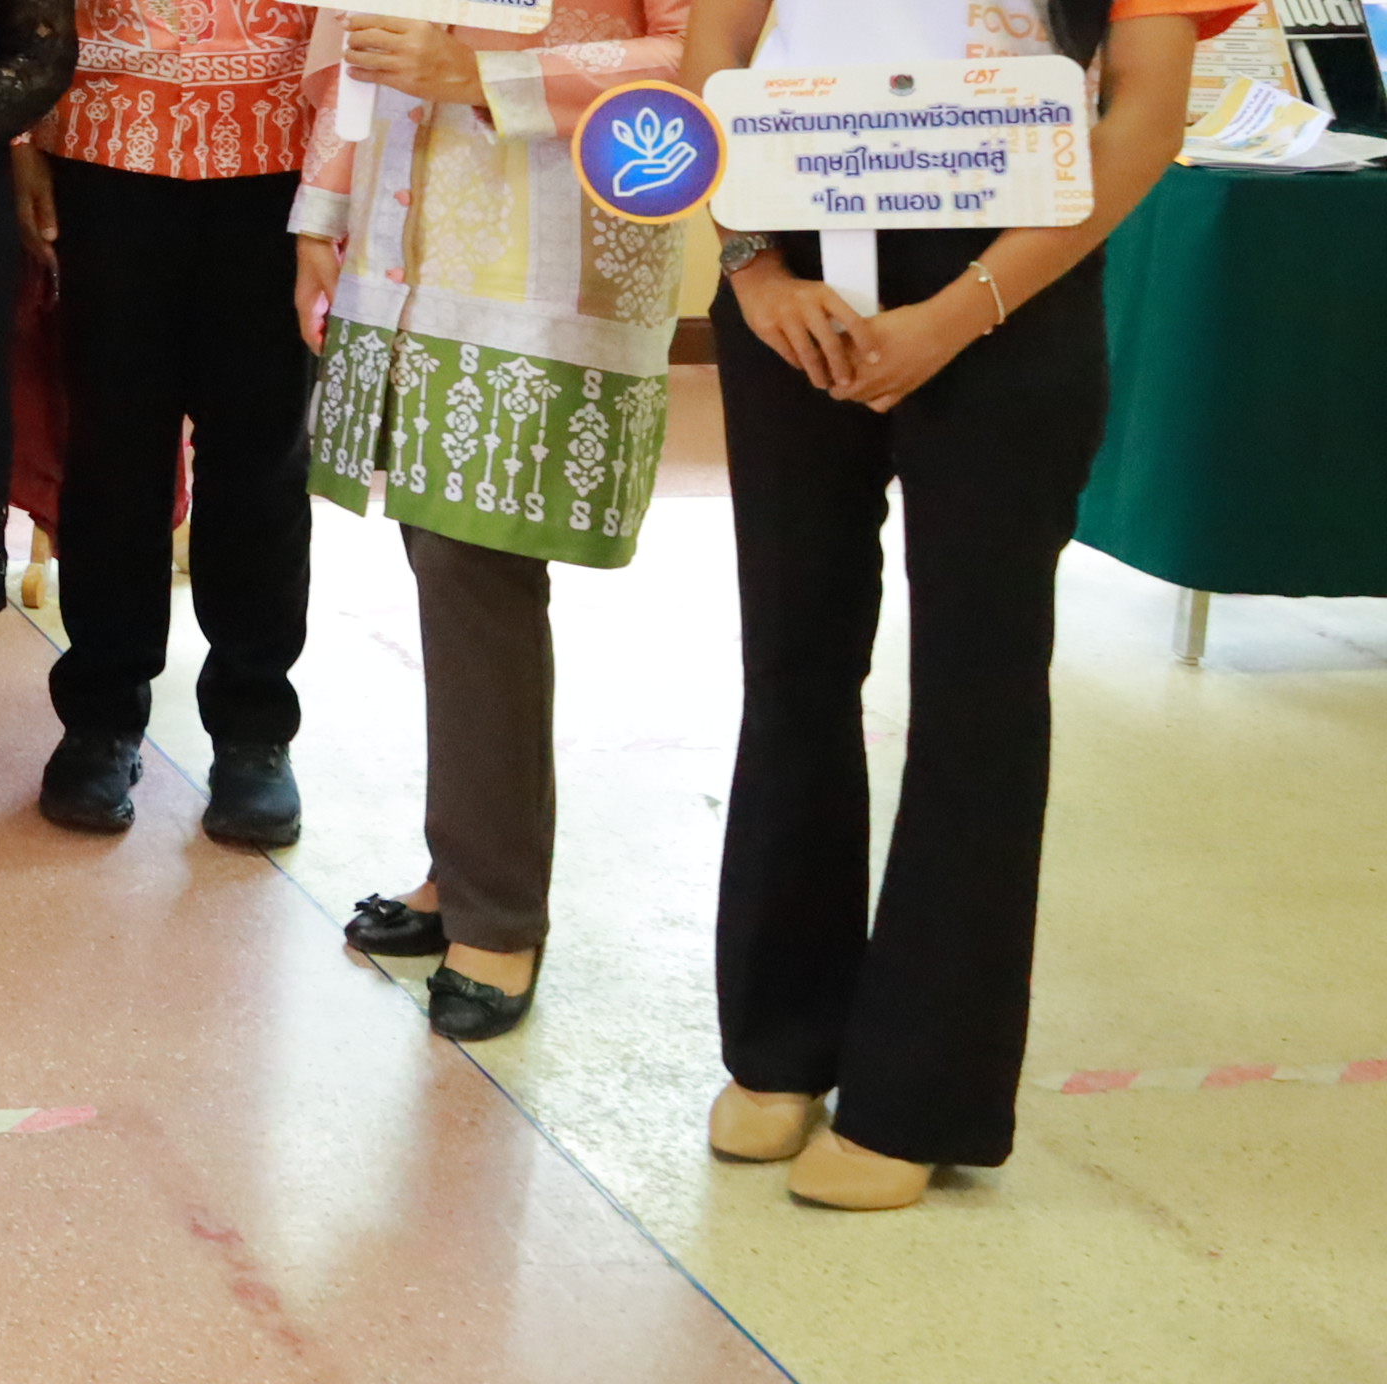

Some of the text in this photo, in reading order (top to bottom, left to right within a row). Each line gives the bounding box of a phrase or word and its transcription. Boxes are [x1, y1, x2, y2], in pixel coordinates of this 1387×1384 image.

[964, 69, 1000, 84] CBT
[733, 100, 1071, 135] การพัฒนาคุณภาพชีวิตตามหลัก
[797, 139, 1006, 175] ทฤษฎีใหม่ประยุกต์สู่
[878, 193, 941, 212] หนอง
